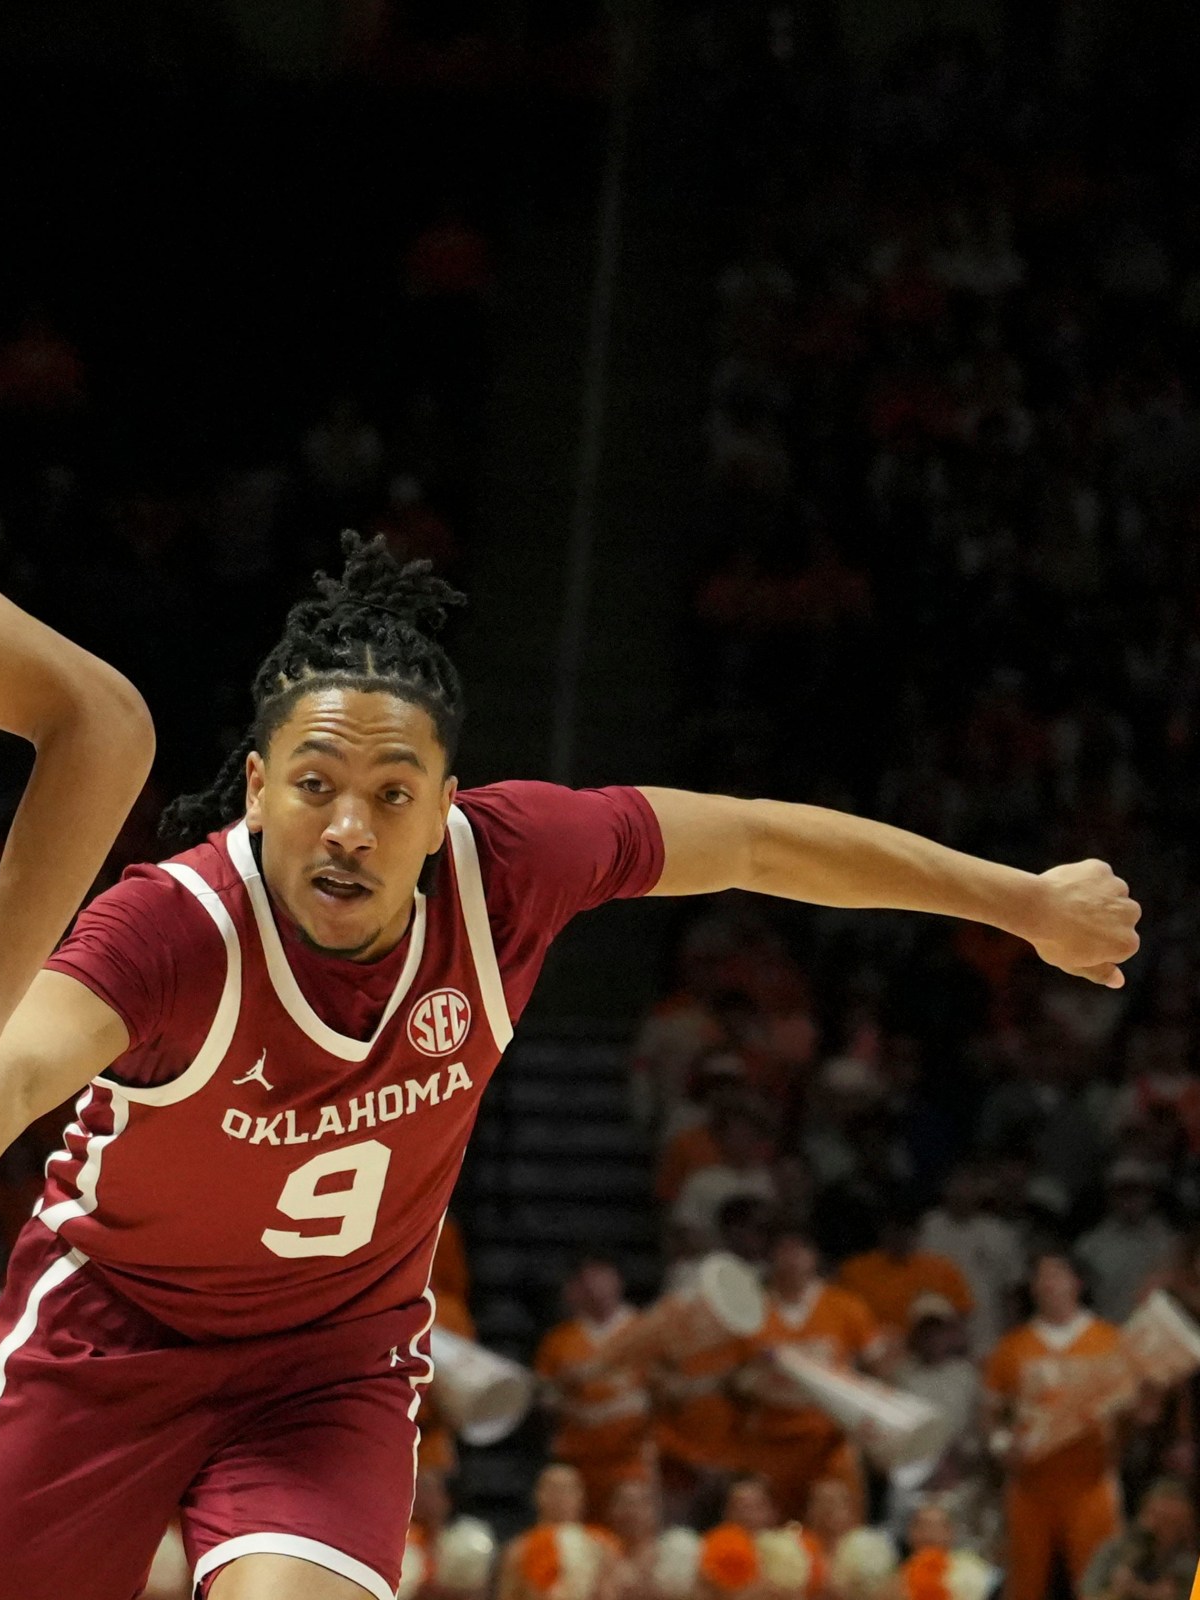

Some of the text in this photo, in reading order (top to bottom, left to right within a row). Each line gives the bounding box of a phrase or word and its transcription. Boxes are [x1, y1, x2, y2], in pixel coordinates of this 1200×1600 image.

[412, 993, 467, 1052] SEC
[221, 1062, 473, 1146] OKLAHOMA
[260, 1139, 392, 1259] 9
